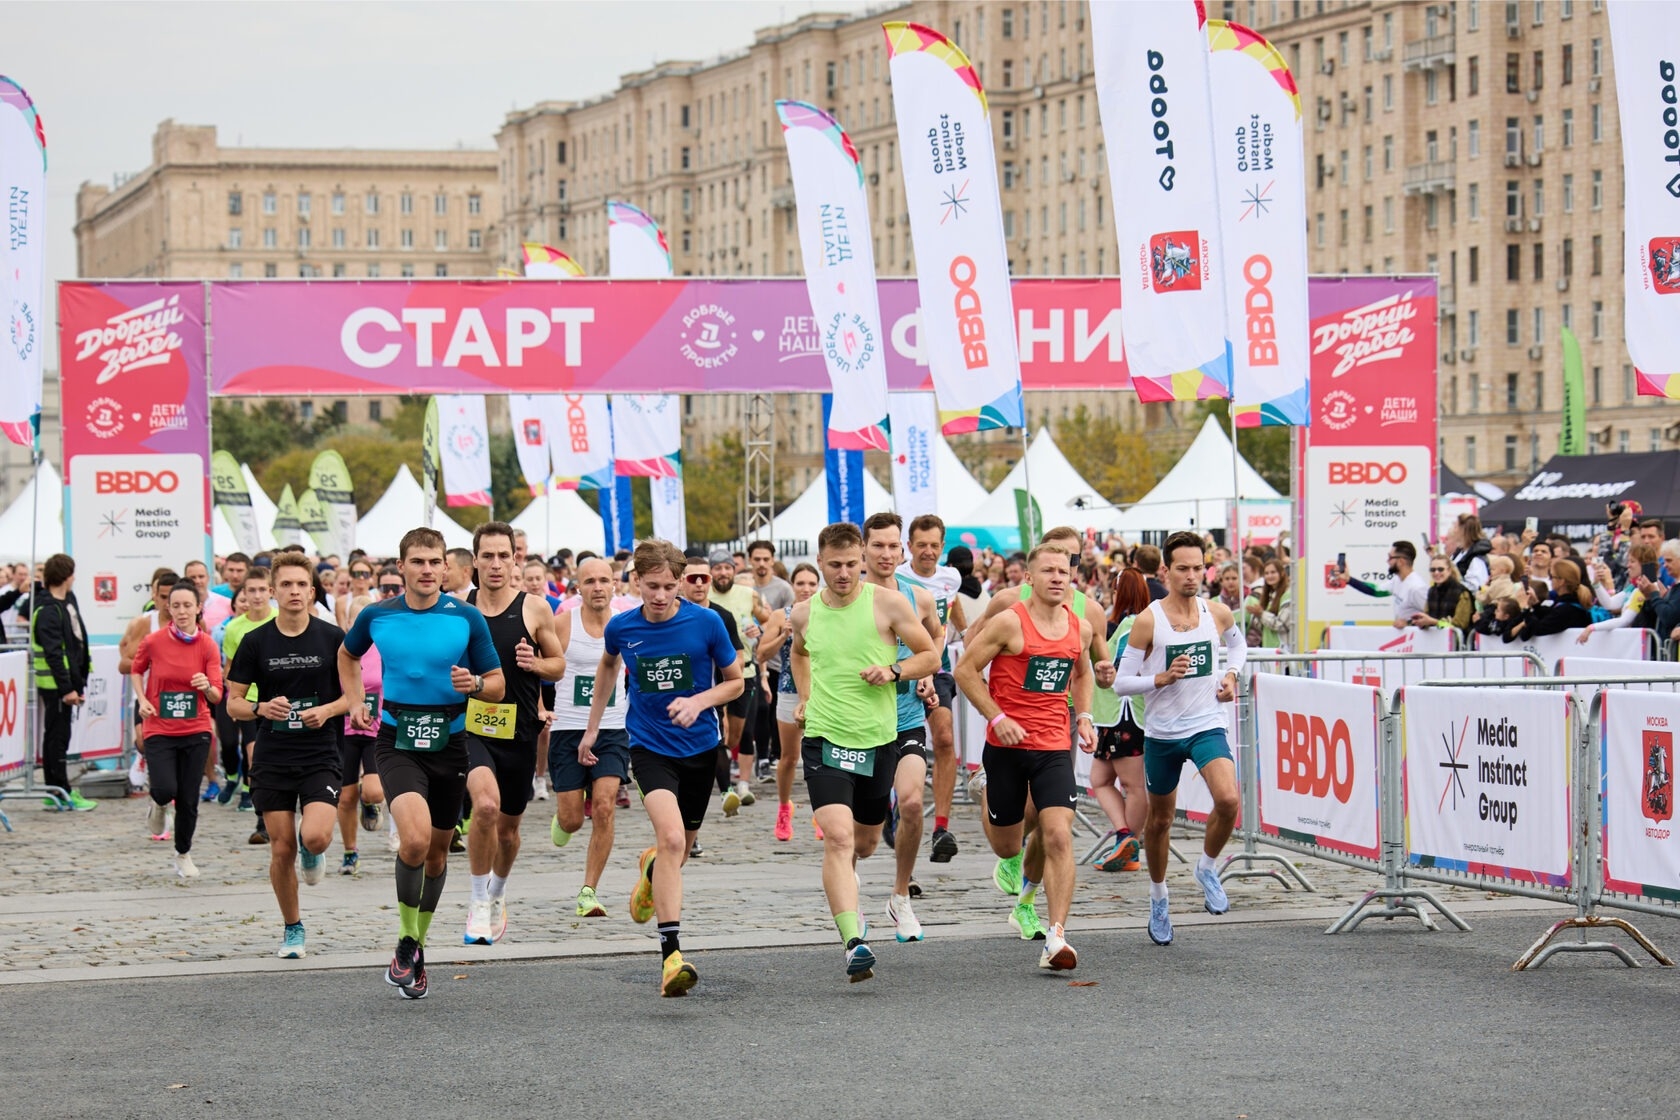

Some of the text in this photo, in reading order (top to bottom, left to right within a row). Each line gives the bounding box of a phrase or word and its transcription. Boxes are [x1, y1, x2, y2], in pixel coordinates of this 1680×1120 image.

[682, 304, 735, 329] ДОБРЫЕ
[1313, 290, 1417, 355] Добрый
[75, 294, 184, 361] Добрый
[782, 316, 819, 333] ДЕТ
[340, 307, 595, 368] СТАРТ
[891, 307, 1123, 366] ФНИ
[779, 336, 823, 352] НАШ
[680, 344, 738, 368] ПРОЕКТЫ
[151, 404, 186, 417] ДЕТИ
[1383, 397, 1415, 410] ДЕТИ
[149, 417, 188, 427] НАШИ
[1381, 410, 1418, 420] НАШИ
[1328, 462, 1407, 485] BBDO
[96, 470, 179, 494] BBDO
[1365, 499, 1399, 507] Media
[135, 508, 171, 517] Media
[1365, 509, 1407, 517] Instinct
[135, 519, 179, 528] Instinct
[1365, 520, 1398, 529] Group
[135, 530, 170, 540] Group
[1373, 572, 1394, 580] Too
[647, 668, 682, 681] 5673
[1035, 669, 1065, 682] 5247
[166, 701, 191, 710] 5461
[474, 713, 507, 727] 2324
[1647, 716, 1668, 727] МОСКВА
[407, 725, 440, 739] 5125
[1477, 717, 1517, 748] Media
[831, 747, 866, 763] 5366
[1276, 710, 1354, 804] BBDO
[1478, 754, 1527, 787] Instinct
[1478, 792, 1517, 831] Group
[1646, 828, 1670, 840] АВТОДОР
